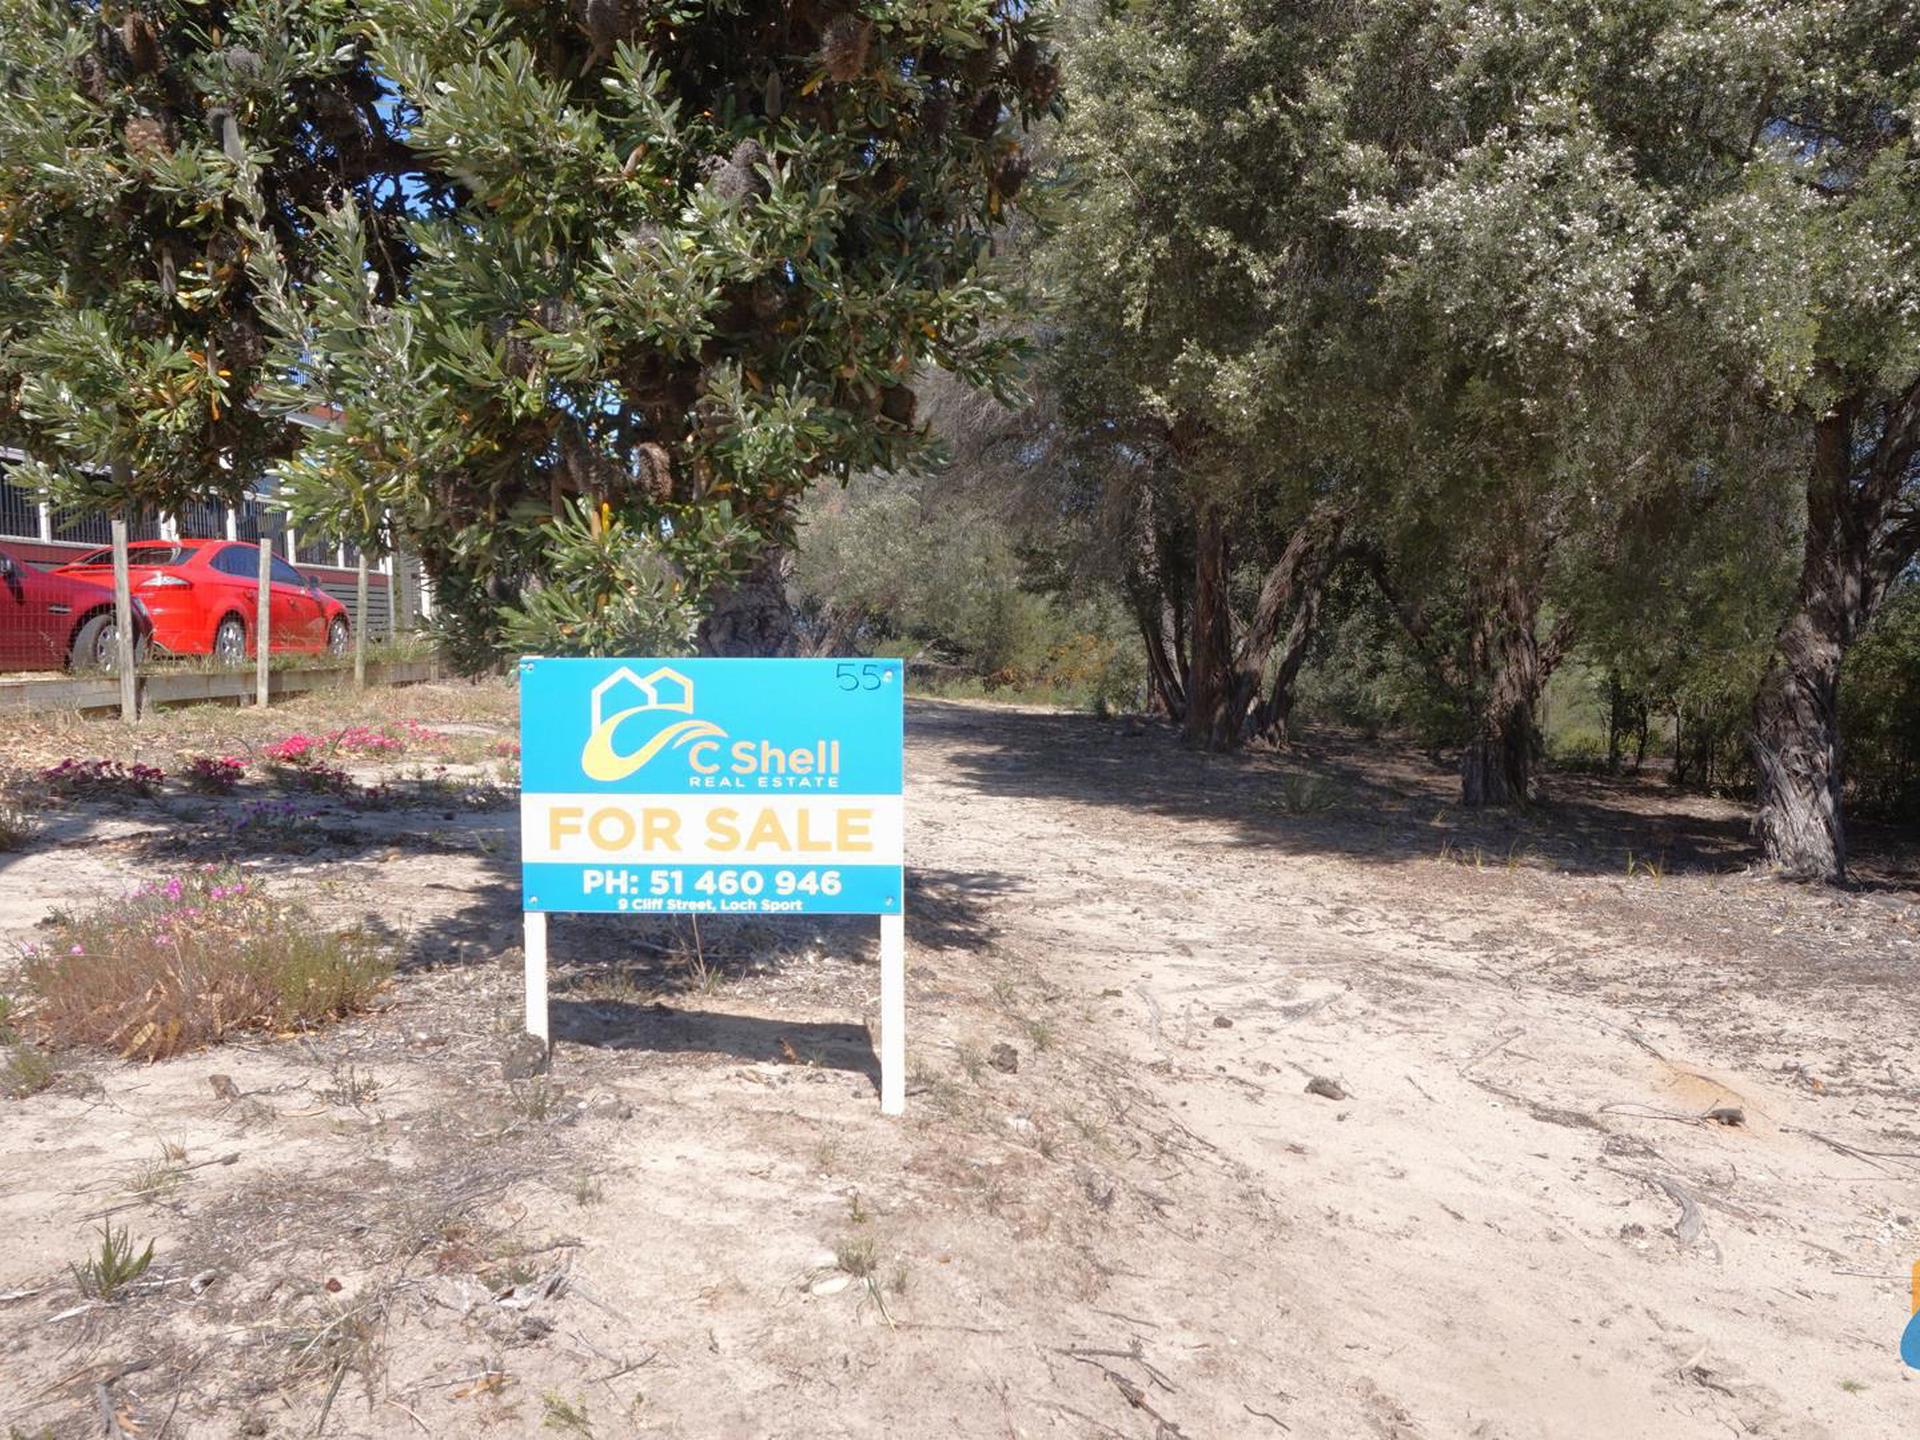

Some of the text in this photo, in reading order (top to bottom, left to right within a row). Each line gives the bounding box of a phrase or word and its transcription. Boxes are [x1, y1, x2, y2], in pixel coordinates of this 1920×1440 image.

[835, 663, 882, 691] 55
[688, 740, 840, 774] C Shell
[689, 776, 840, 788] REAL ESTATE
[548, 806, 873, 853] FOR SALE
[583, 869, 842, 896] PH: 51 460 946
[618, 898, 803, 913] 9 Cliff Street, Loch Sport
